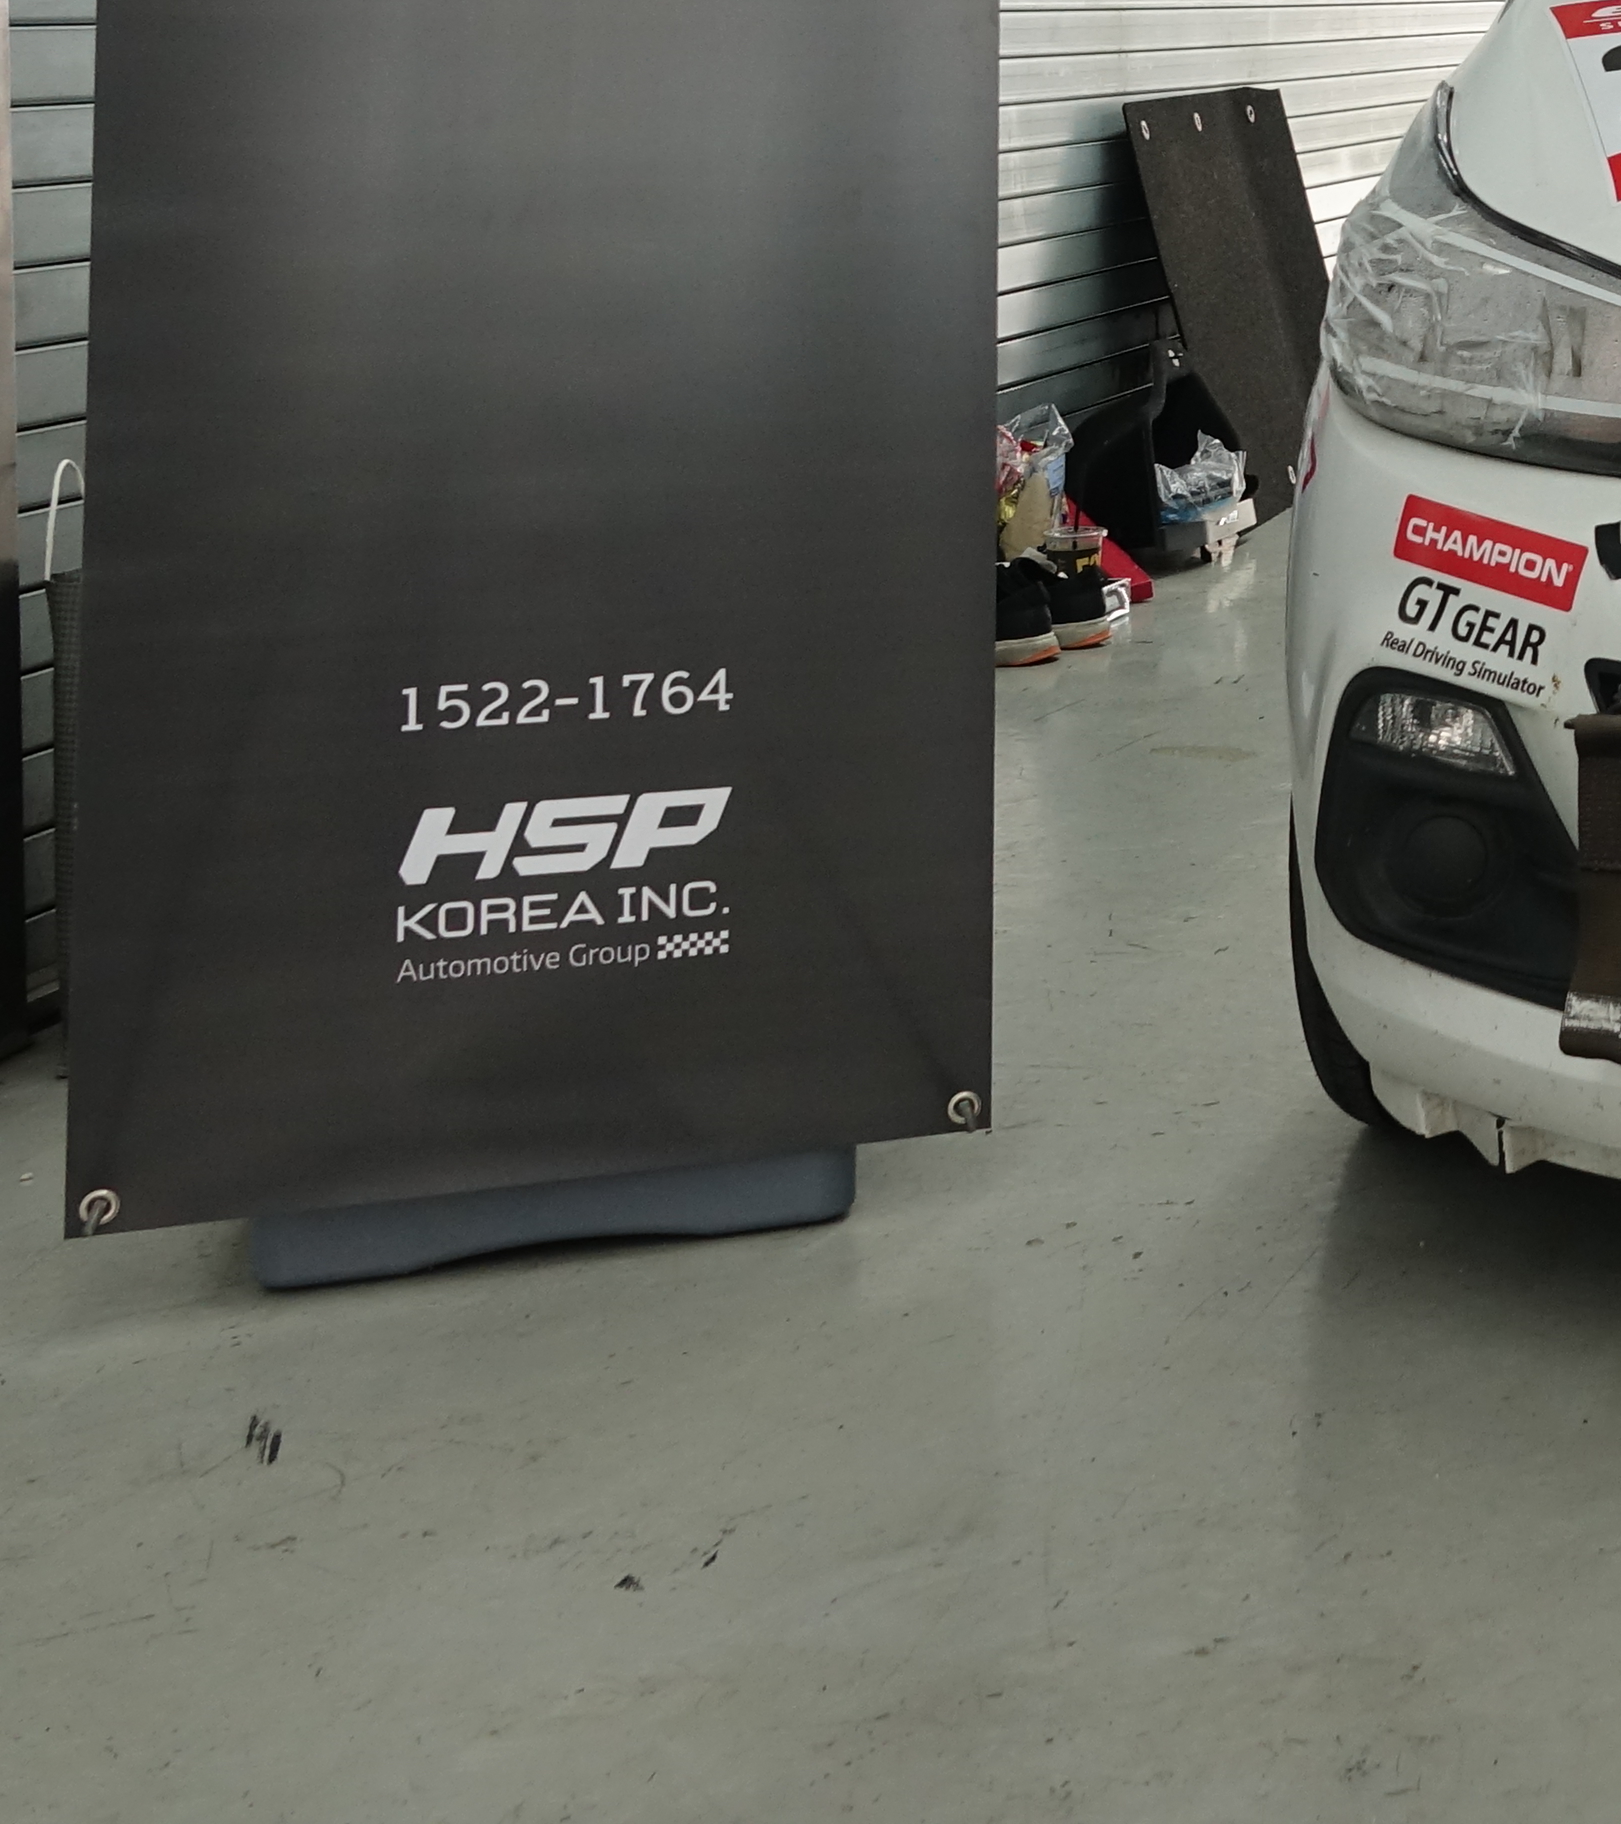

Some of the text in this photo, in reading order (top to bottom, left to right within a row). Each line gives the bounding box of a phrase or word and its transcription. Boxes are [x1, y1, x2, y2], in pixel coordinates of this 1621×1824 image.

[1405, 516, 1572, 588] CHAMPION
[1396, 576, 1547, 666] GT GEAR
[1380, 630, 1546, 699] Real Driving Simulator
[401, 668, 734, 732] 1522-1764
[398, 786, 733, 885] HSP
[396, 880, 731, 943] KOREA INC.
[396, 938, 651, 984] Automotive Group
